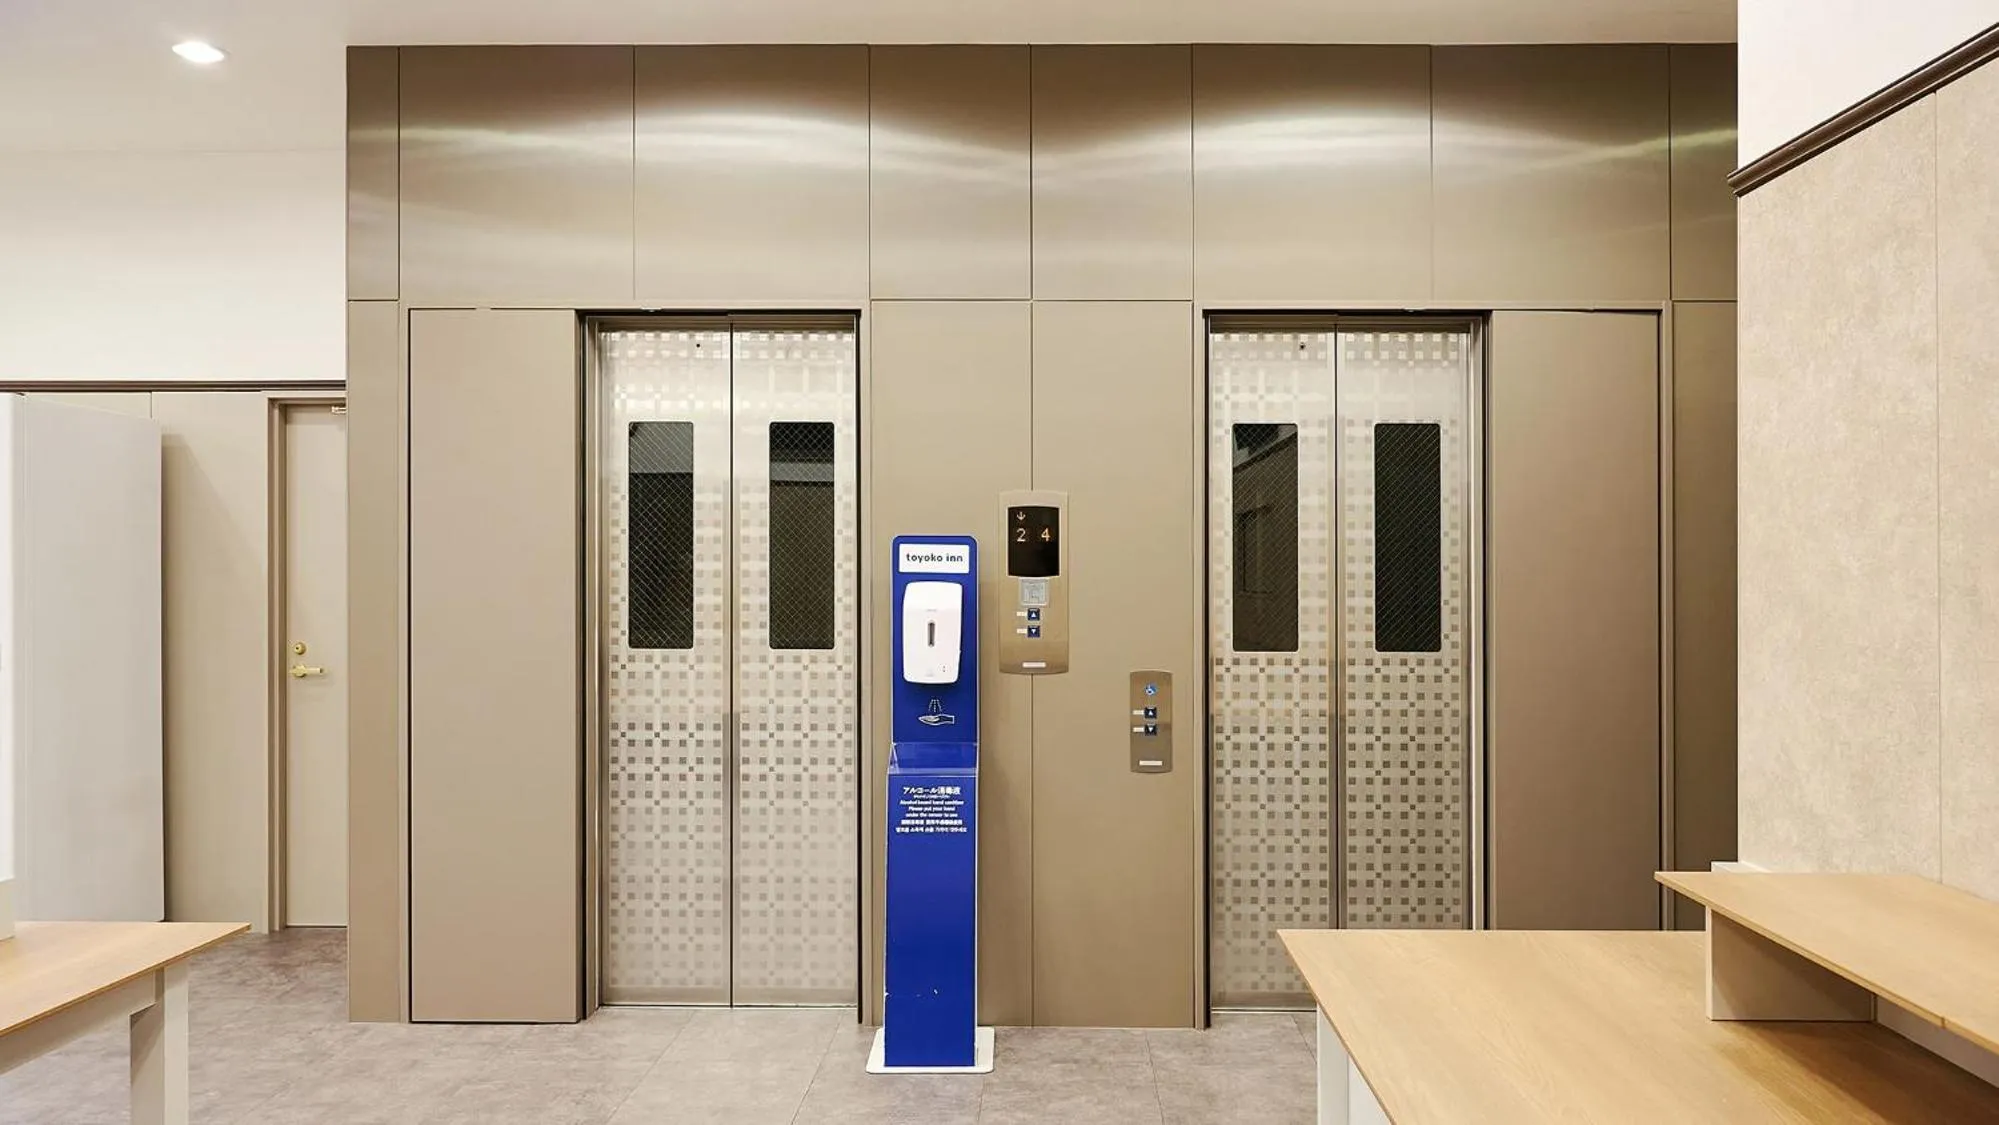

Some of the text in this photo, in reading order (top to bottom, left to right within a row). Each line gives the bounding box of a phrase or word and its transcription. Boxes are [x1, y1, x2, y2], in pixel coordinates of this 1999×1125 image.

[1016, 527, 1026, 542] 2
[1041, 527, 1051, 542] 4
[906, 553, 963, 563] toyoko inn
